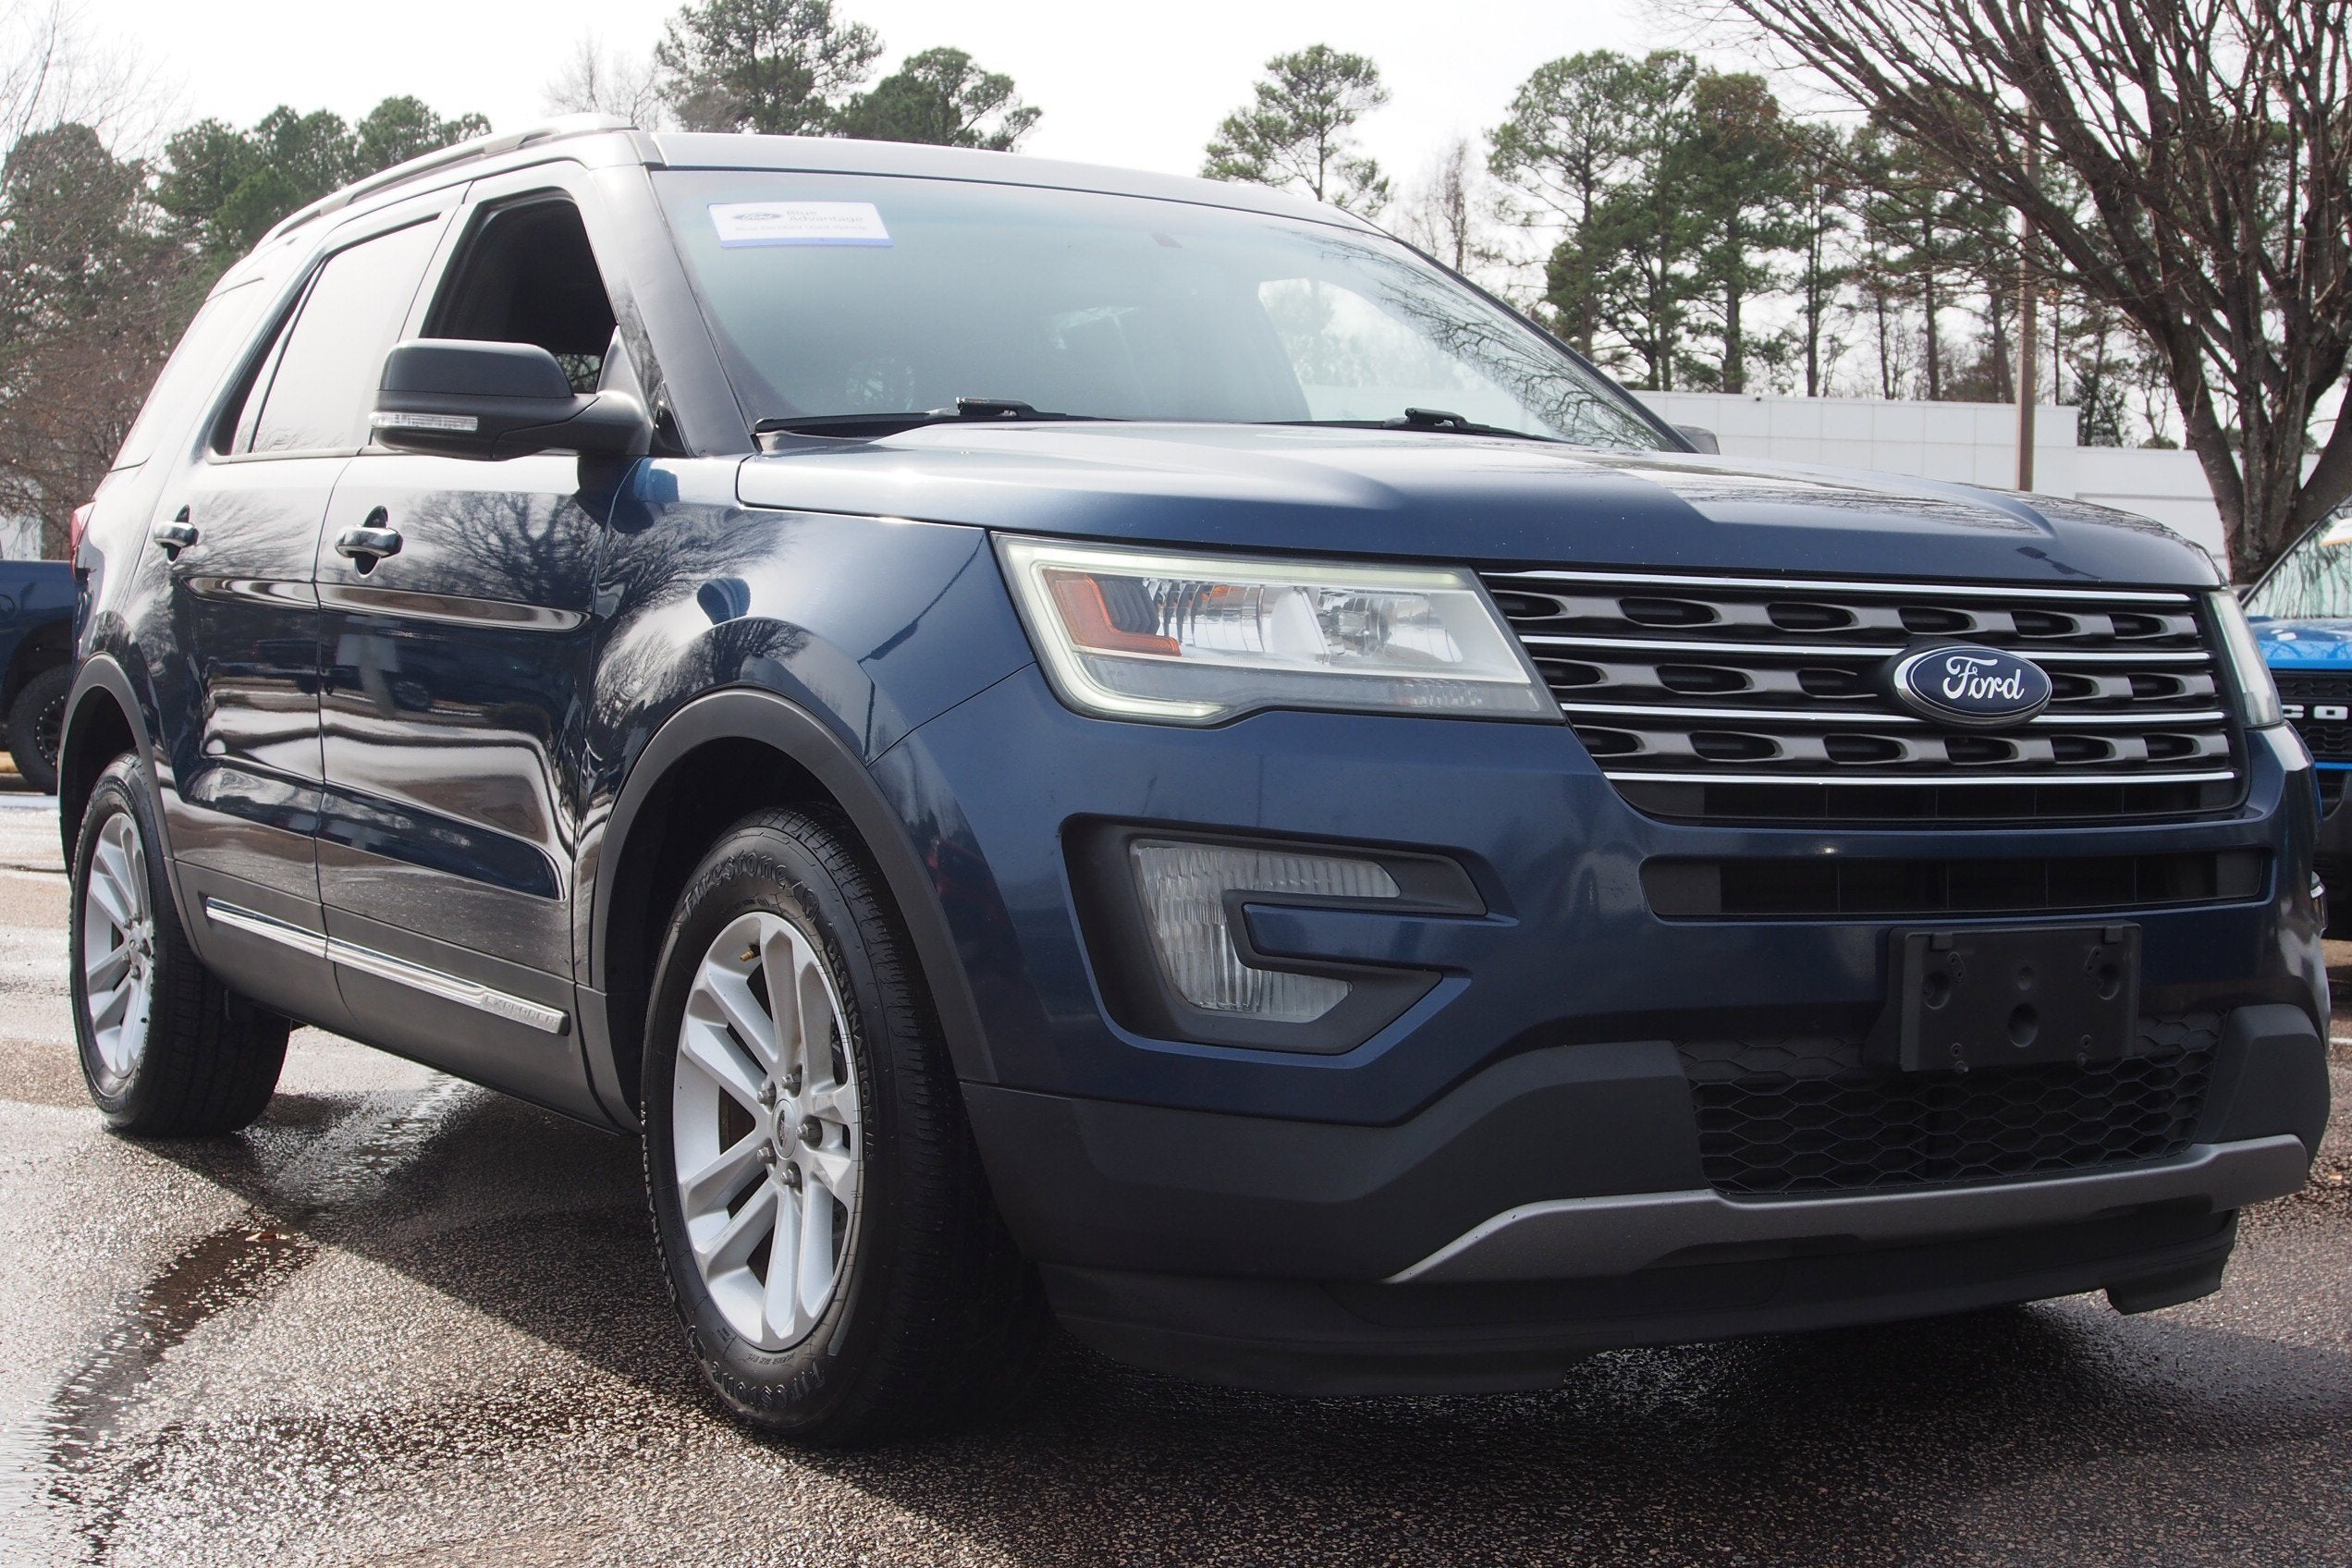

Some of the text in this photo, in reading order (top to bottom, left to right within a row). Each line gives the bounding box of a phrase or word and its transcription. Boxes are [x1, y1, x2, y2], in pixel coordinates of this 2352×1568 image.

[1942, 655, 2025, 700] Ford
[681, 848, 790, 923] Firestone
[827, 939, 873, 1125] DESTINATION
